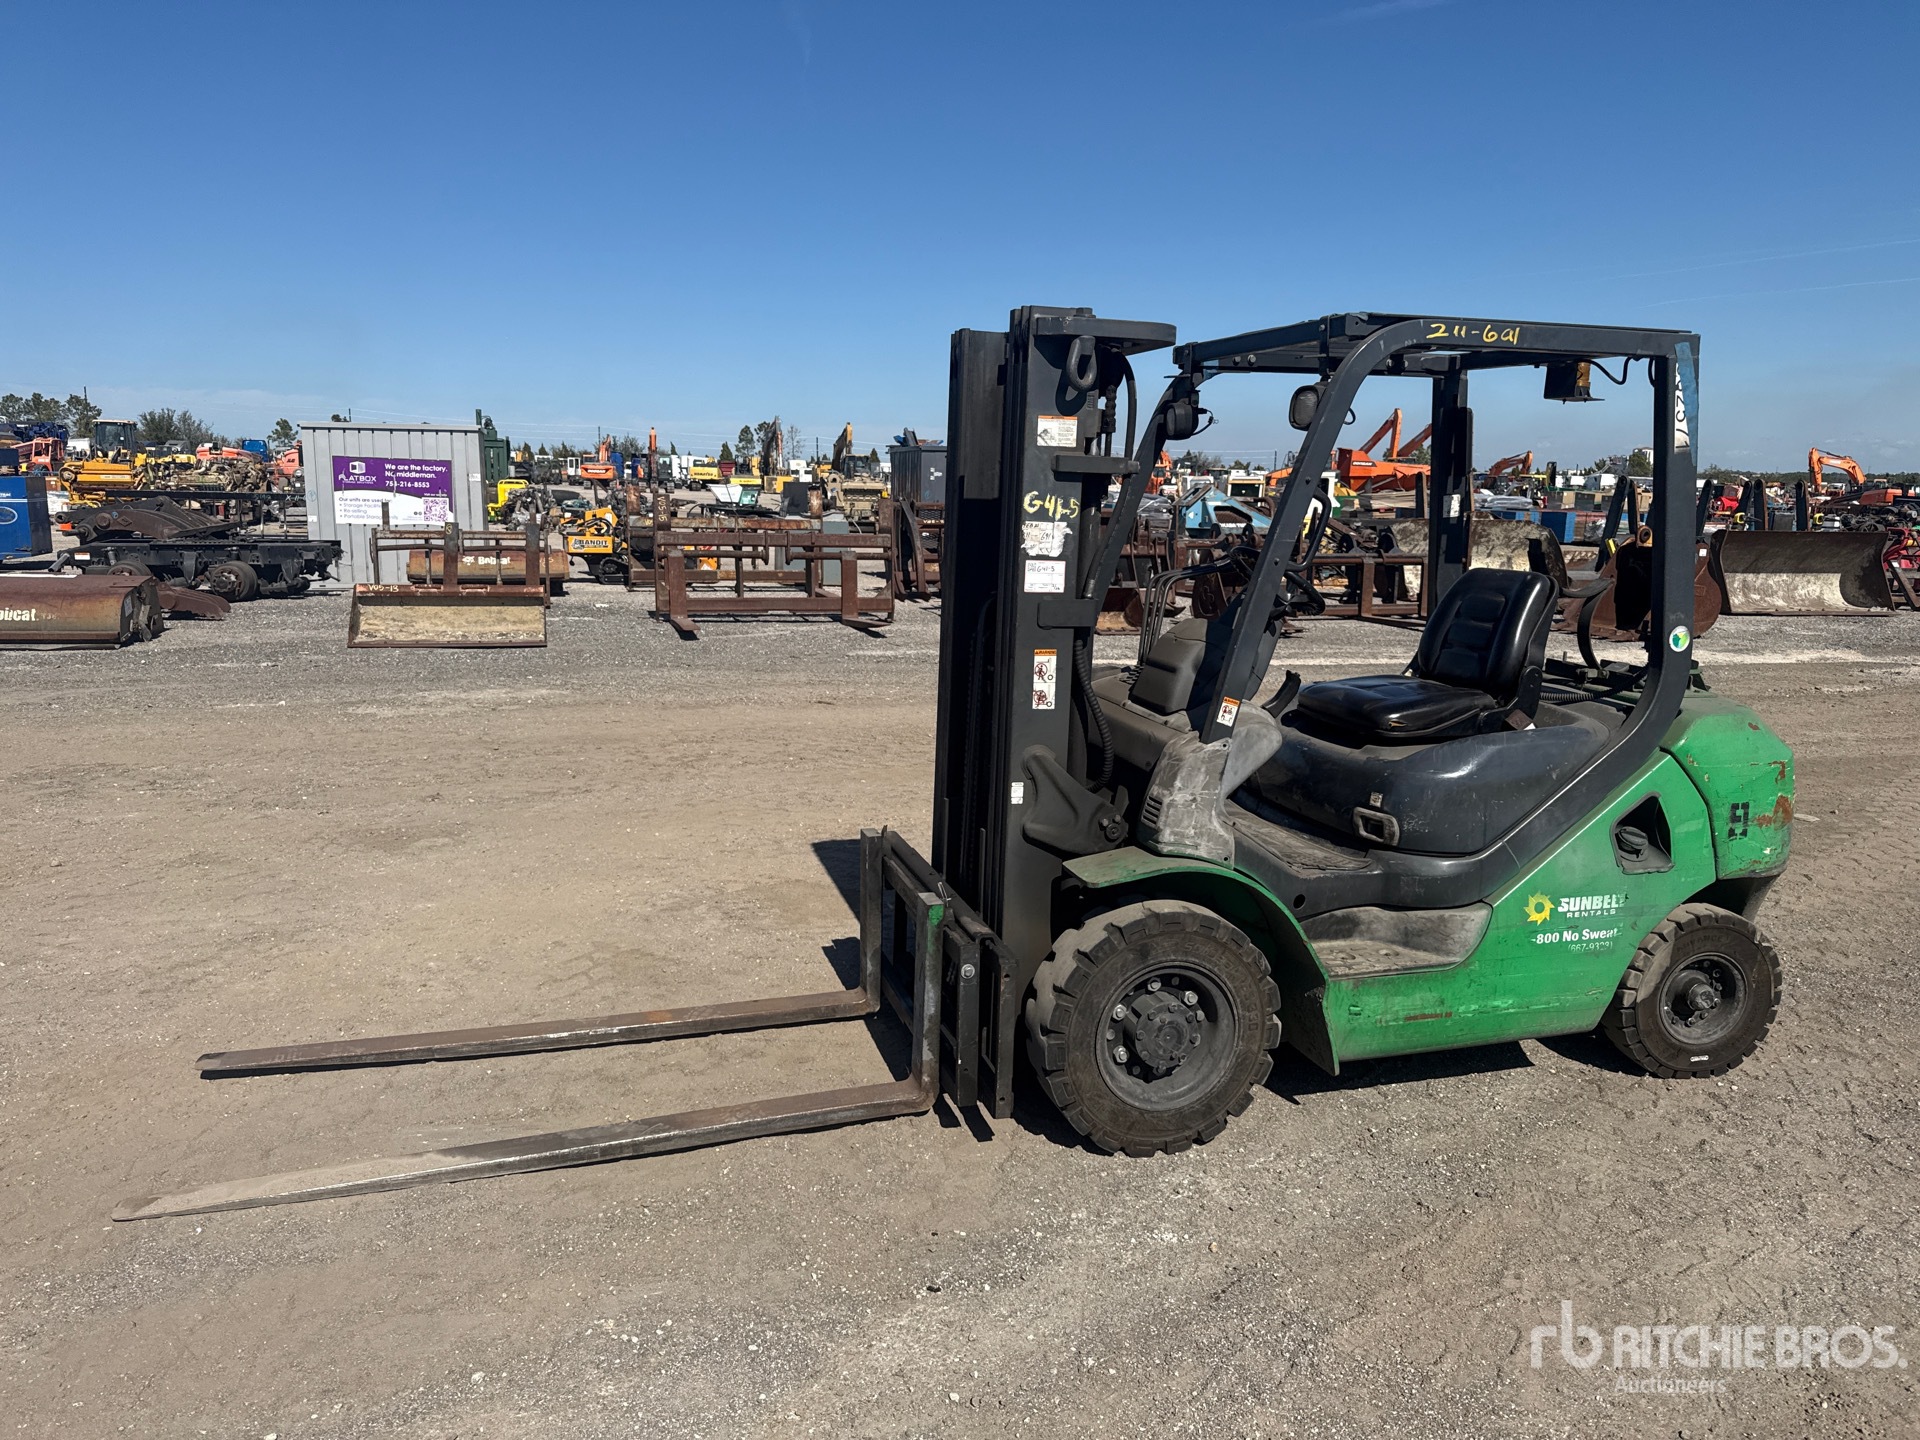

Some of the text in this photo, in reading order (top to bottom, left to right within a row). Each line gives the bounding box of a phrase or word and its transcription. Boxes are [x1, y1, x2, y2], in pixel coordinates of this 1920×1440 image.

[422, 465, 448, 473] factory.
[396, 471, 437, 479] middleman.
[478, 556, 511, 565] Bobat
[1567, 909, 1616, 918] RENTALS
[1562, 930, 1579, 942] No
